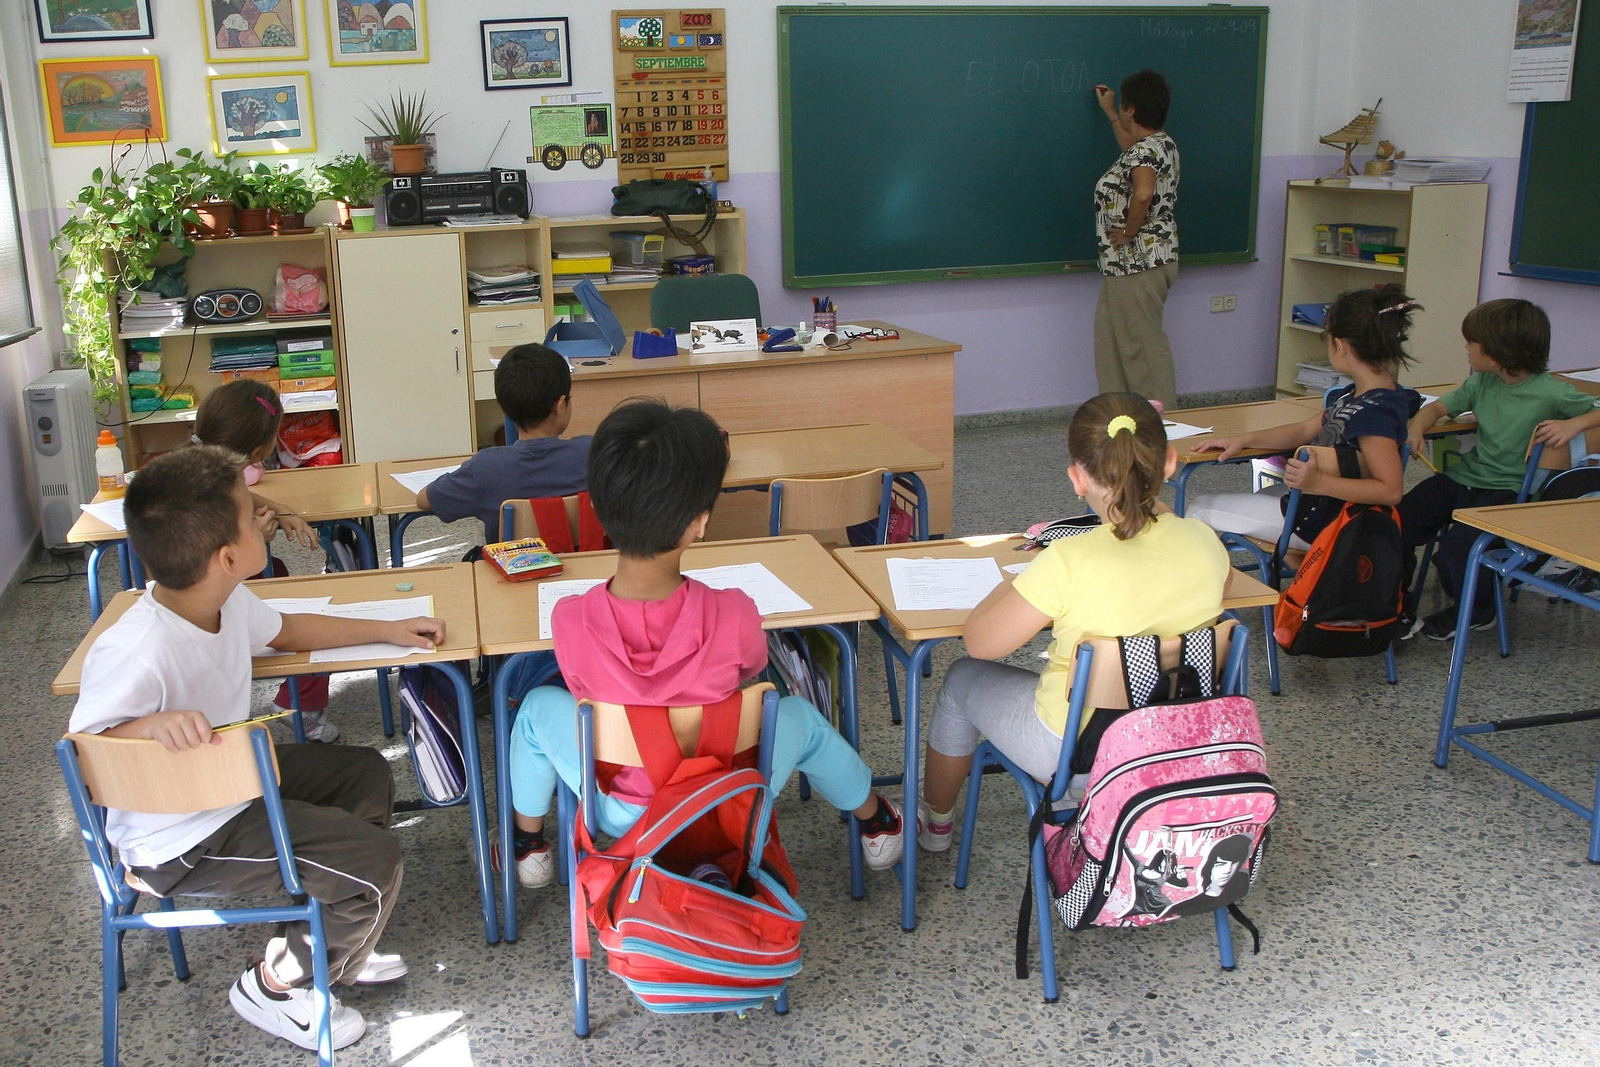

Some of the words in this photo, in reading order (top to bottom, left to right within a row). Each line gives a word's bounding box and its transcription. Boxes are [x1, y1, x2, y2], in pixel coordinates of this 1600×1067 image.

[684, 13, 712, 25] 2009
[1141, 18, 1194, 48] Málaga
[636, 57, 705, 69] SEPTIEMBRE
[962, 57, 1002, 97] EL
[637, 92, 641, 102] 1
[651, 91, 658, 101] 2
[667, 91, 674, 101] 3
[682, 90, 689, 100] 4
[697, 90, 704, 100] 5
[712, 90, 719, 100] 6
[621, 107, 629, 118] 7
[637, 107, 644, 117] 8
[653, 107, 660, 117] 9
[667, 106, 677, 116] 10
[684, 105, 691, 116] 11
[698, 105, 708, 115] 12
[712, 104, 722, 114] 13
[621, 123, 631, 133] 14
[636, 122, 646, 132] 15
[651, 122, 661, 132] 16
[667, 121, 677, 131] 17
[682, 121, 692, 131] 18
[697, 120, 707, 130] 19
[711, 120, 724, 130] 20
[621, 139, 631, 149] 21
[635, 137, 648, 148] 22
[652, 137, 665, 147] 23
[667, 136, 680, 147] 24
[682, 136, 695, 146] 25
[698, 135, 711, 145] 26
[713, 134, 726, 144] 27
[621, 153, 634, 163] 28
[637, 153, 650, 163] 29
[652, 152, 665, 163] 30
